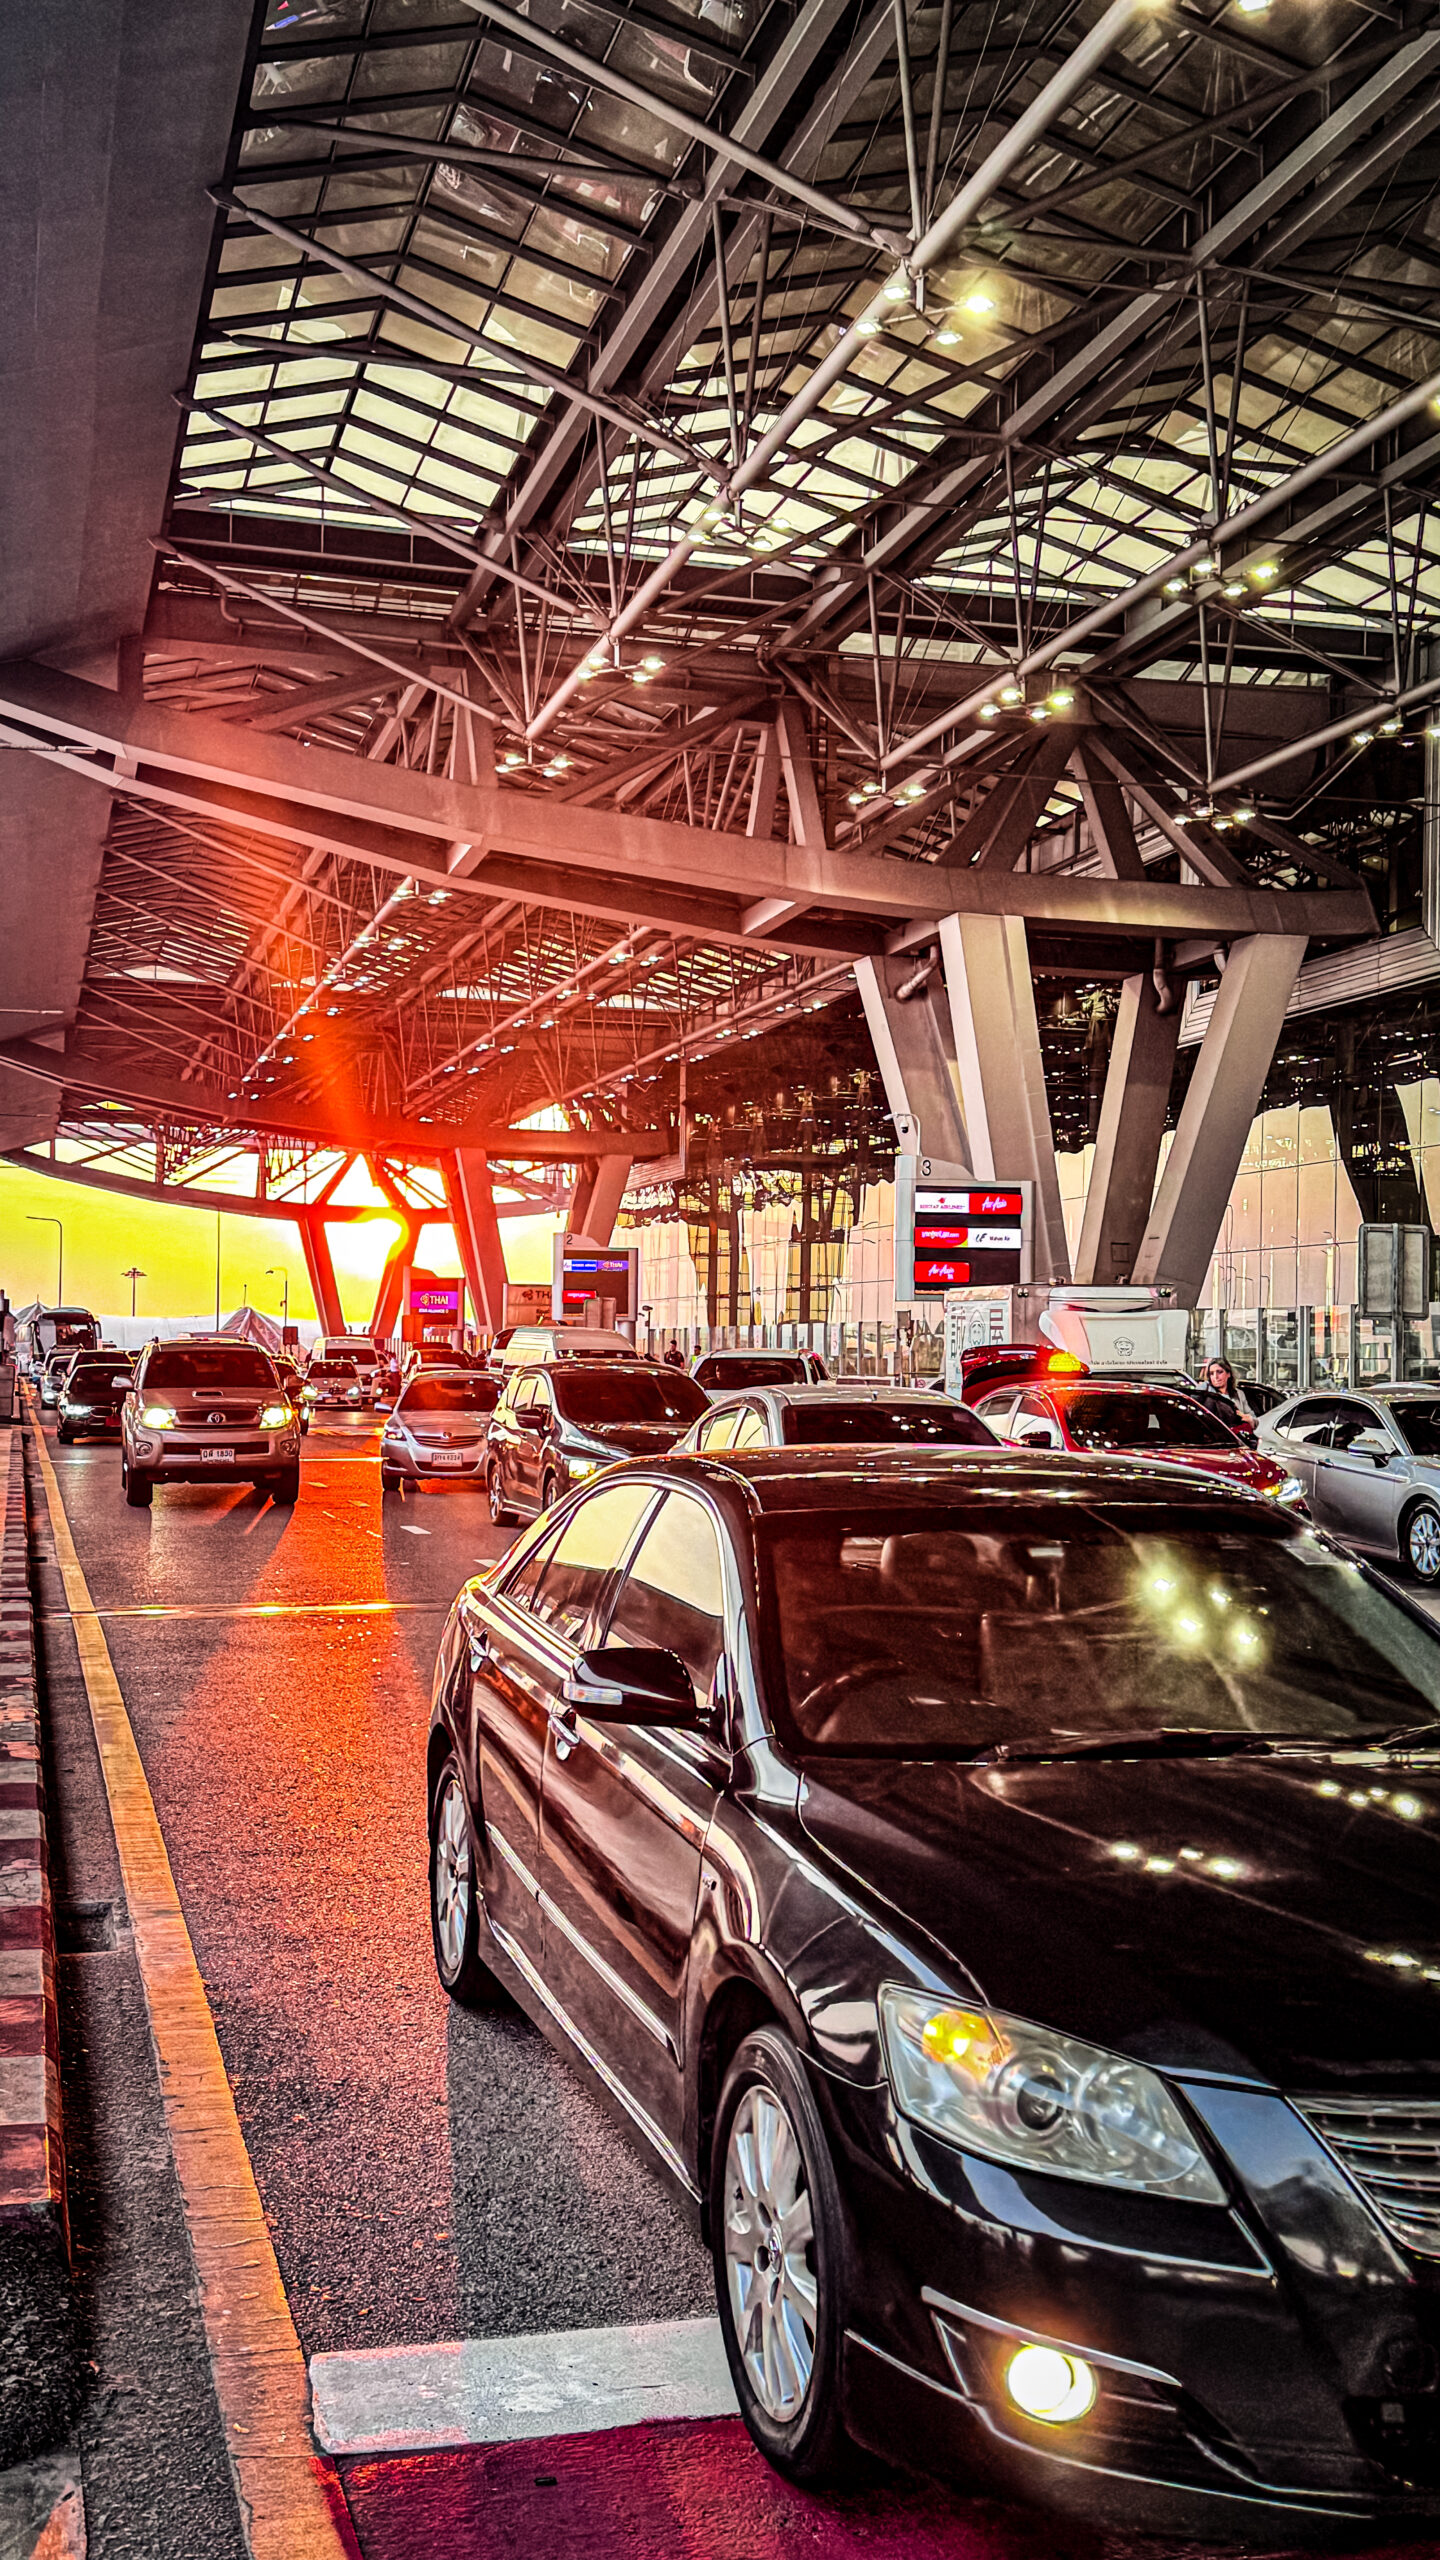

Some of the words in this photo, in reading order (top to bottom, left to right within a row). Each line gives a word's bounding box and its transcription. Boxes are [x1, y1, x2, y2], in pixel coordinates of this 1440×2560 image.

[922, 1159, 932, 1177] 3
[566, 1234, 573, 1245] 2
[430, 1295, 449, 1305] THAI
